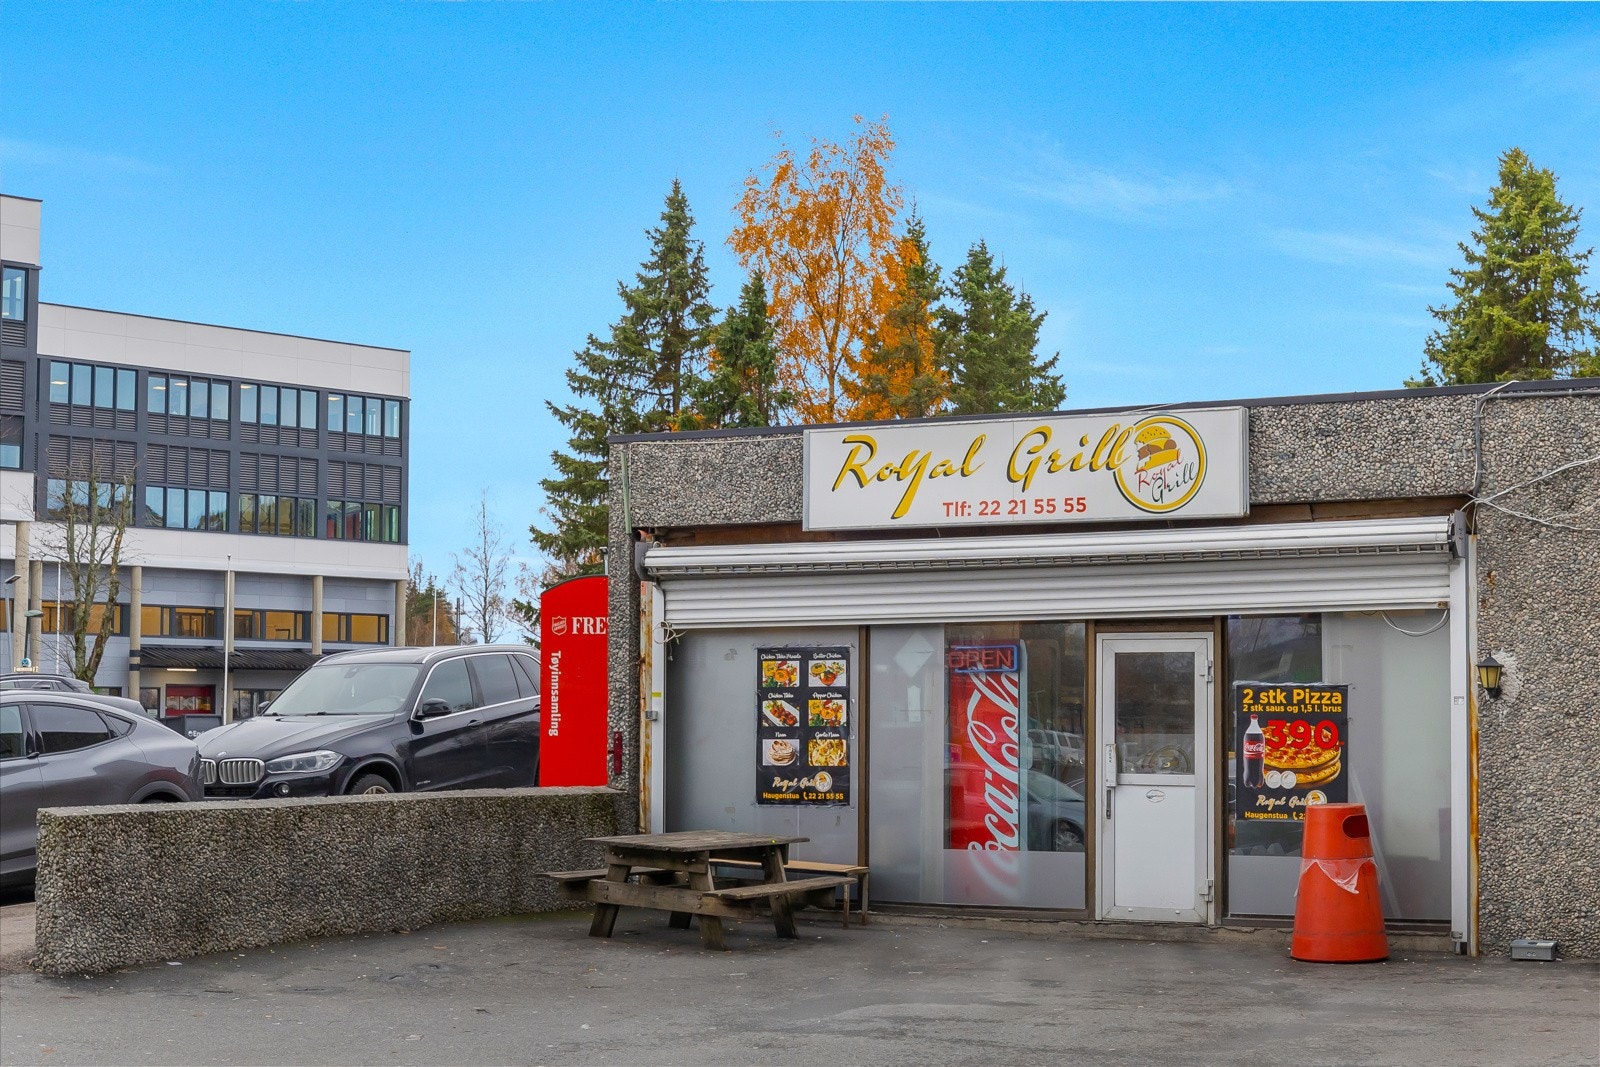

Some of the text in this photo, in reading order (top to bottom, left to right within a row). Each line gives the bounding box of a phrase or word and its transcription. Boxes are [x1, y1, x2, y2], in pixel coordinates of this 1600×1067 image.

[832, 424, 1133, 519] Royal Grill
[1135, 448, 1183, 493] Royal
[1152, 462, 1197, 504] Grill
[943, 497, 1087, 517] Tlf: 22 21 55 55
[571, 616, 608, 635] FRE
[948, 649, 1012, 668] OPEN
[548, 650, 562, 737] Tøyinnsamling
[1243, 688, 1342, 704] 2 stk Pizza
[1243, 704, 1249, 712] 2
[1250, 704, 1263, 712] stk
[1300, 705, 1313, 713] 1,5
[1322, 704, 1342, 712] brus
[772, 776, 798, 792] Royal
[763, 792, 800, 800] Haugenstua
[1256, 794, 1286, 811] Royal
[1244, 811, 1306, 820] Haugenstua 2
